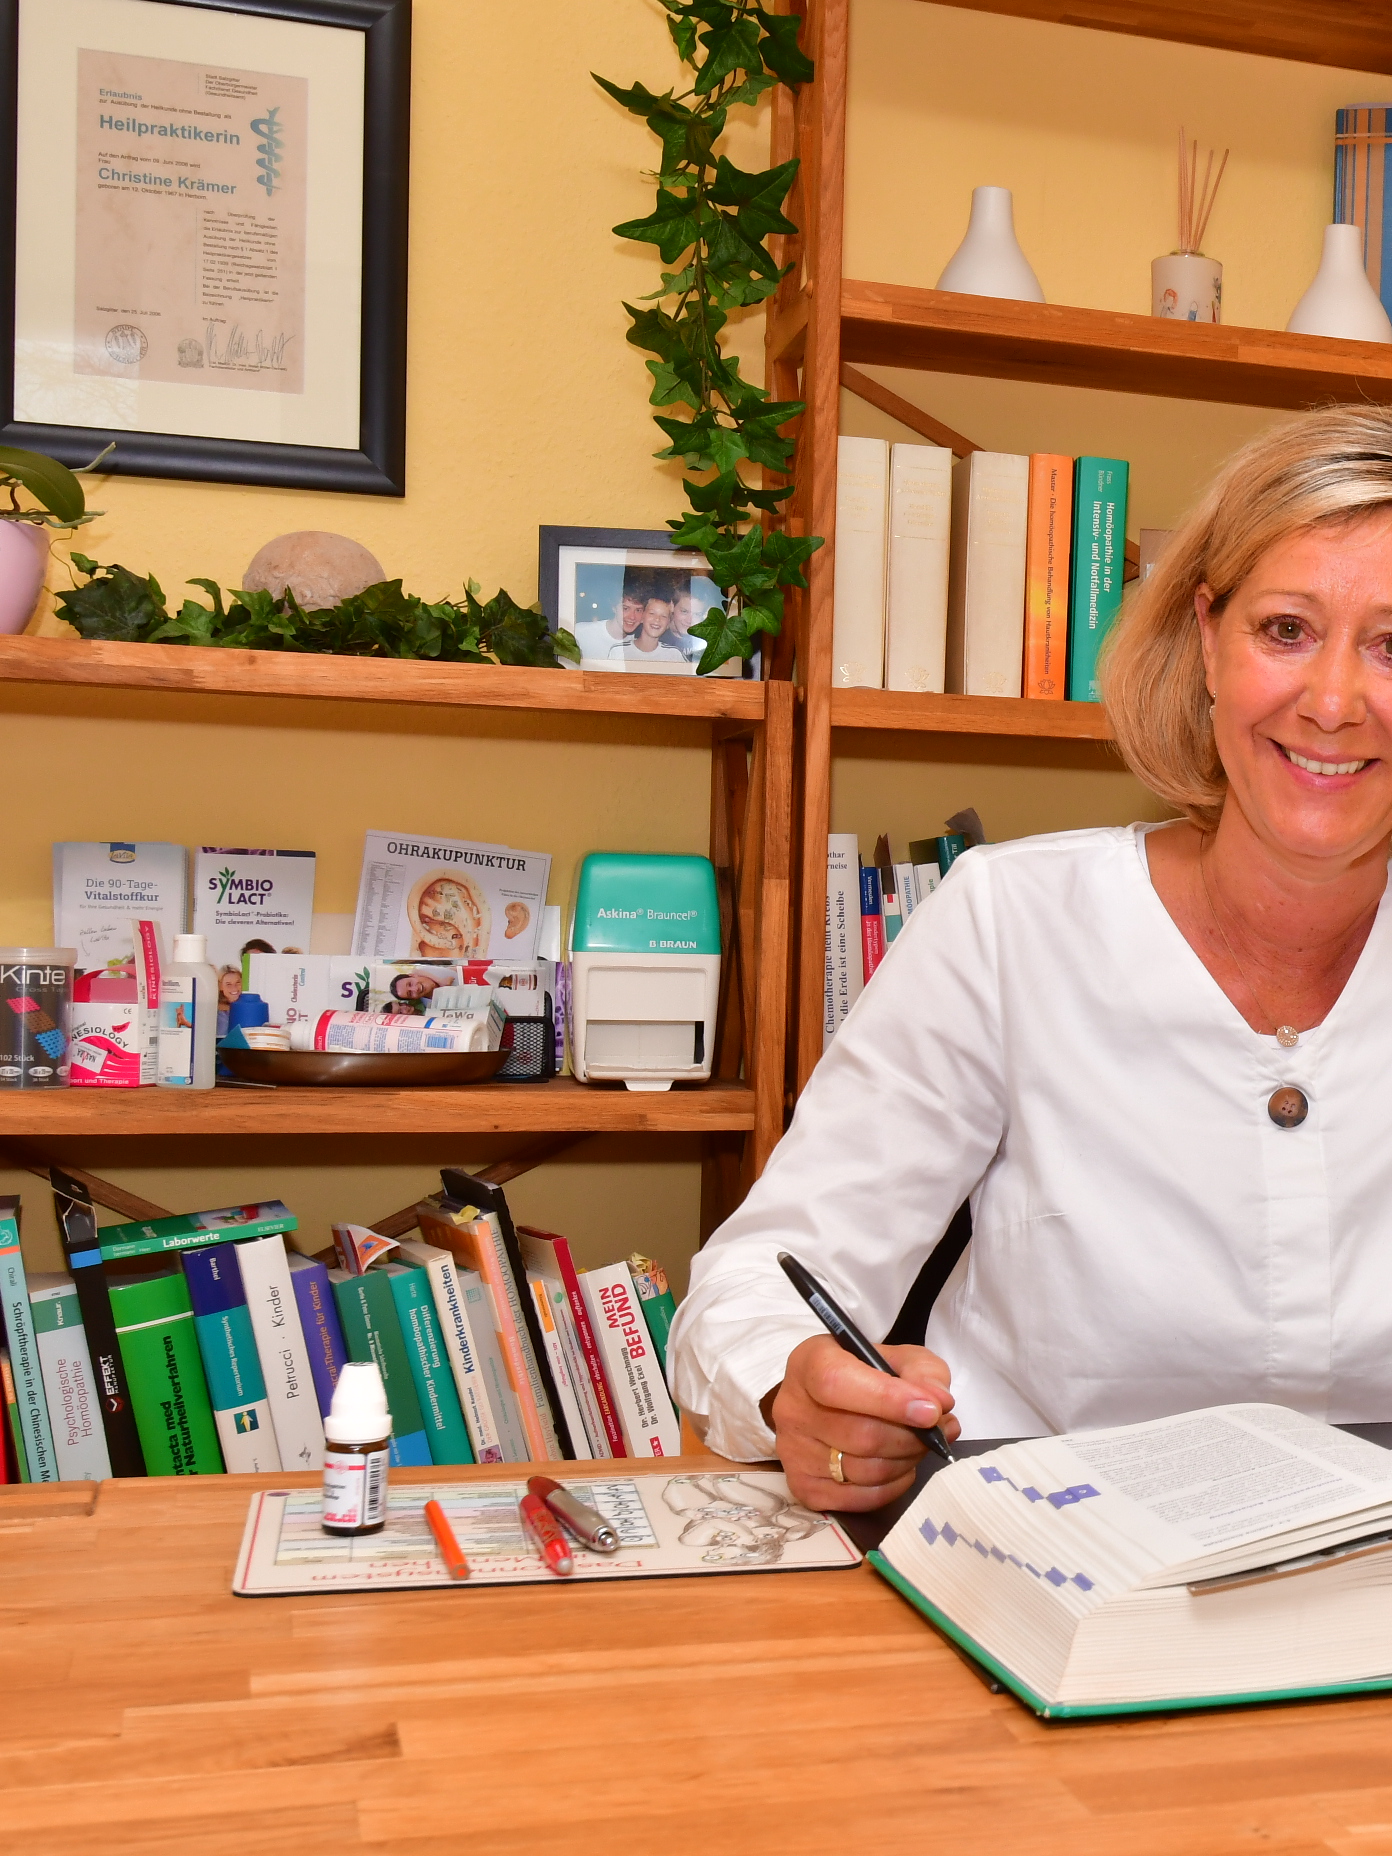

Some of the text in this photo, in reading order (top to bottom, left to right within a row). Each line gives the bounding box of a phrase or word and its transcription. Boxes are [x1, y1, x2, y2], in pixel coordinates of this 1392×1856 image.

[99, 88, 143, 101] Erlaubnis
[99, 114, 240, 146] Heilpraktikerin
[98, 167, 237, 195] Christine Krämer
[1050, 468, 1058, 492] Master
[1049, 498, 1057, 509] Die
[1047, 510, 1056, 565] homöopathische
[1102, 501, 1115, 593] Homöopathie in der
[1088, 500, 1103, 630] Intensiv- und Notfallmedizin
[1045, 566, 1054, 605] Behandlung
[1044, 620, 1052, 675] Hautkrankheiten
[387, 841, 527, 872] OHRAKUPUNKTUR
[84, 890, 159, 902] Vitalstoffkur
[85, 878, 158, 892] Die 90-Tage-
[208, 876, 274, 903] SYMBIO
[255, 919, 295, 927] Alternativen!
[649, 940, 697, 949] B BRAUN
[836, 890, 849, 1018] die Erde ist eine Scheibe
[144, 925, 157, 1001] KINESIOLOGY
[824, 955, 834, 1034] Chemotherapie
[13, 1054, 35, 1062] Stück
[162, 1232, 220, 1248] Laborwerte
[209, 1257, 221, 1281] Barthel
[310, 1280, 322, 1311] Kinder
[569, 1289, 584, 1316] auftanken
[598, 1286, 621, 1330] MEIN
[314, 1312, 325, 1325] für
[441, 1264, 476, 1375] Kinderkrankheiten
[510, 1308, 522, 1325] der
[611, 1282, 647, 1360] BEFUND
[13, 1301, 34, 1376] Schröpftherapie
[267, 1285, 300, 1400] Petrucci Kinder
[420, 1305, 441, 1368] Differenzierung
[578, 1320, 593, 1349] entspannen
[221, 1315, 244, 1397] Synthetisches Repertorium
[408, 1308, 447, 1431] homöopathischer Kindermittel
[514, 1324, 545, 1409] Familienhandbuch
[587, 1353, 601, 1381] abschalten
[25, 1378, 34, 1388] in
[99, 1356, 115, 1396] EFFEKT
[620, 1346, 649, 1429] Dr. Herbert Woschnagg
[27, 1390, 38, 1406] der
[56, 1358, 79, 1447] Psychologische
[72, 1360, 93, 1438] Homöopathie
[163, 1335, 197, 1467] Naturheilverfahren
[635, 1364, 659, 1425] Dr. Wolfgang Exel
[160, 1400, 176, 1431] med
[605, 1413, 619, 1442] Faszination
[30, 1408, 48, 1469] Chinesischen
